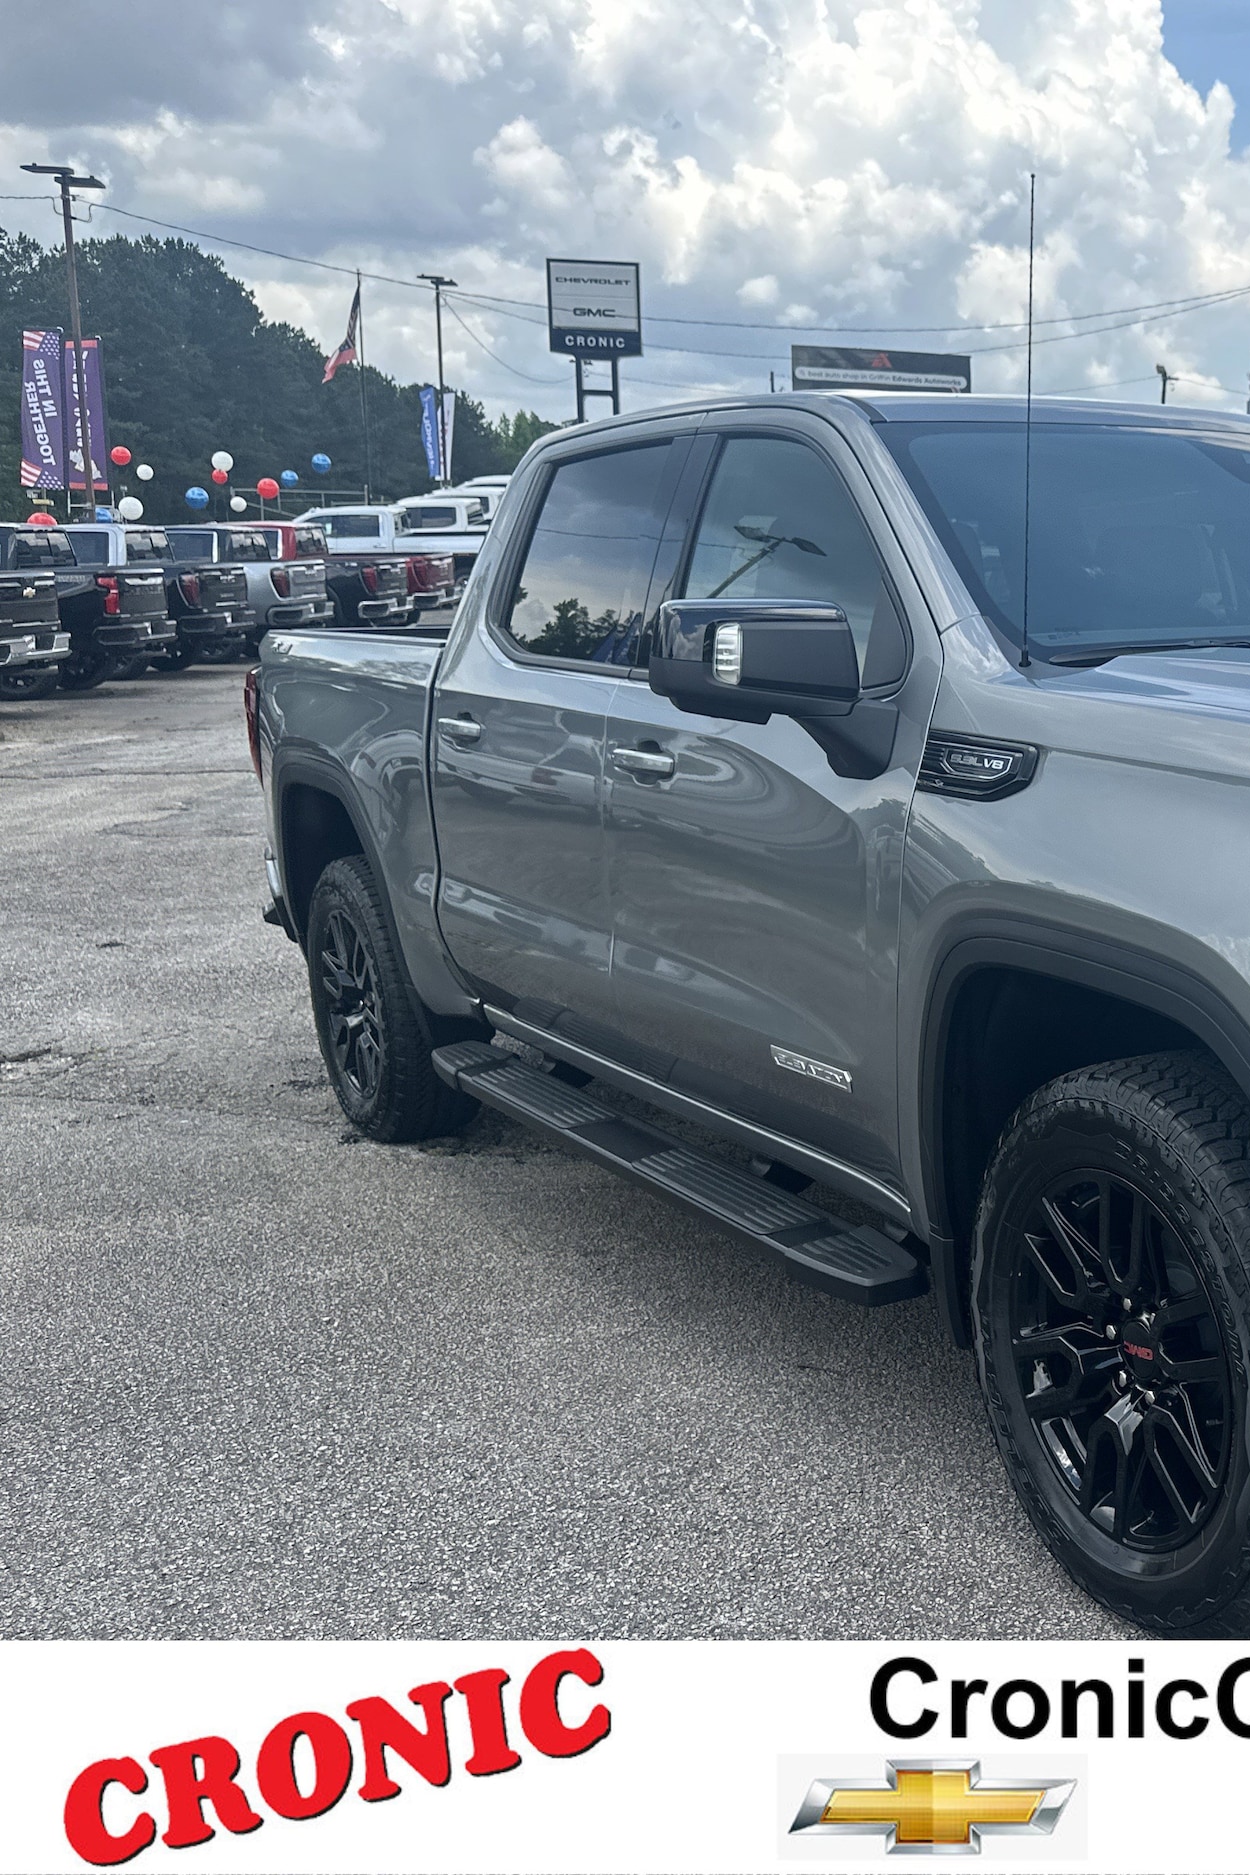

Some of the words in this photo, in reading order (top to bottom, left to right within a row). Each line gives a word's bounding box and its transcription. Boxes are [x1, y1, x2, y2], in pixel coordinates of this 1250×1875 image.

[555, 276, 631, 286] CHEVROLET
[573, 307, 616, 318] GMC
[564, 335, 625, 349] CRONIC
[983, 758, 1005, 770] V8
[1123, 1340, 1154, 1361] GMC
